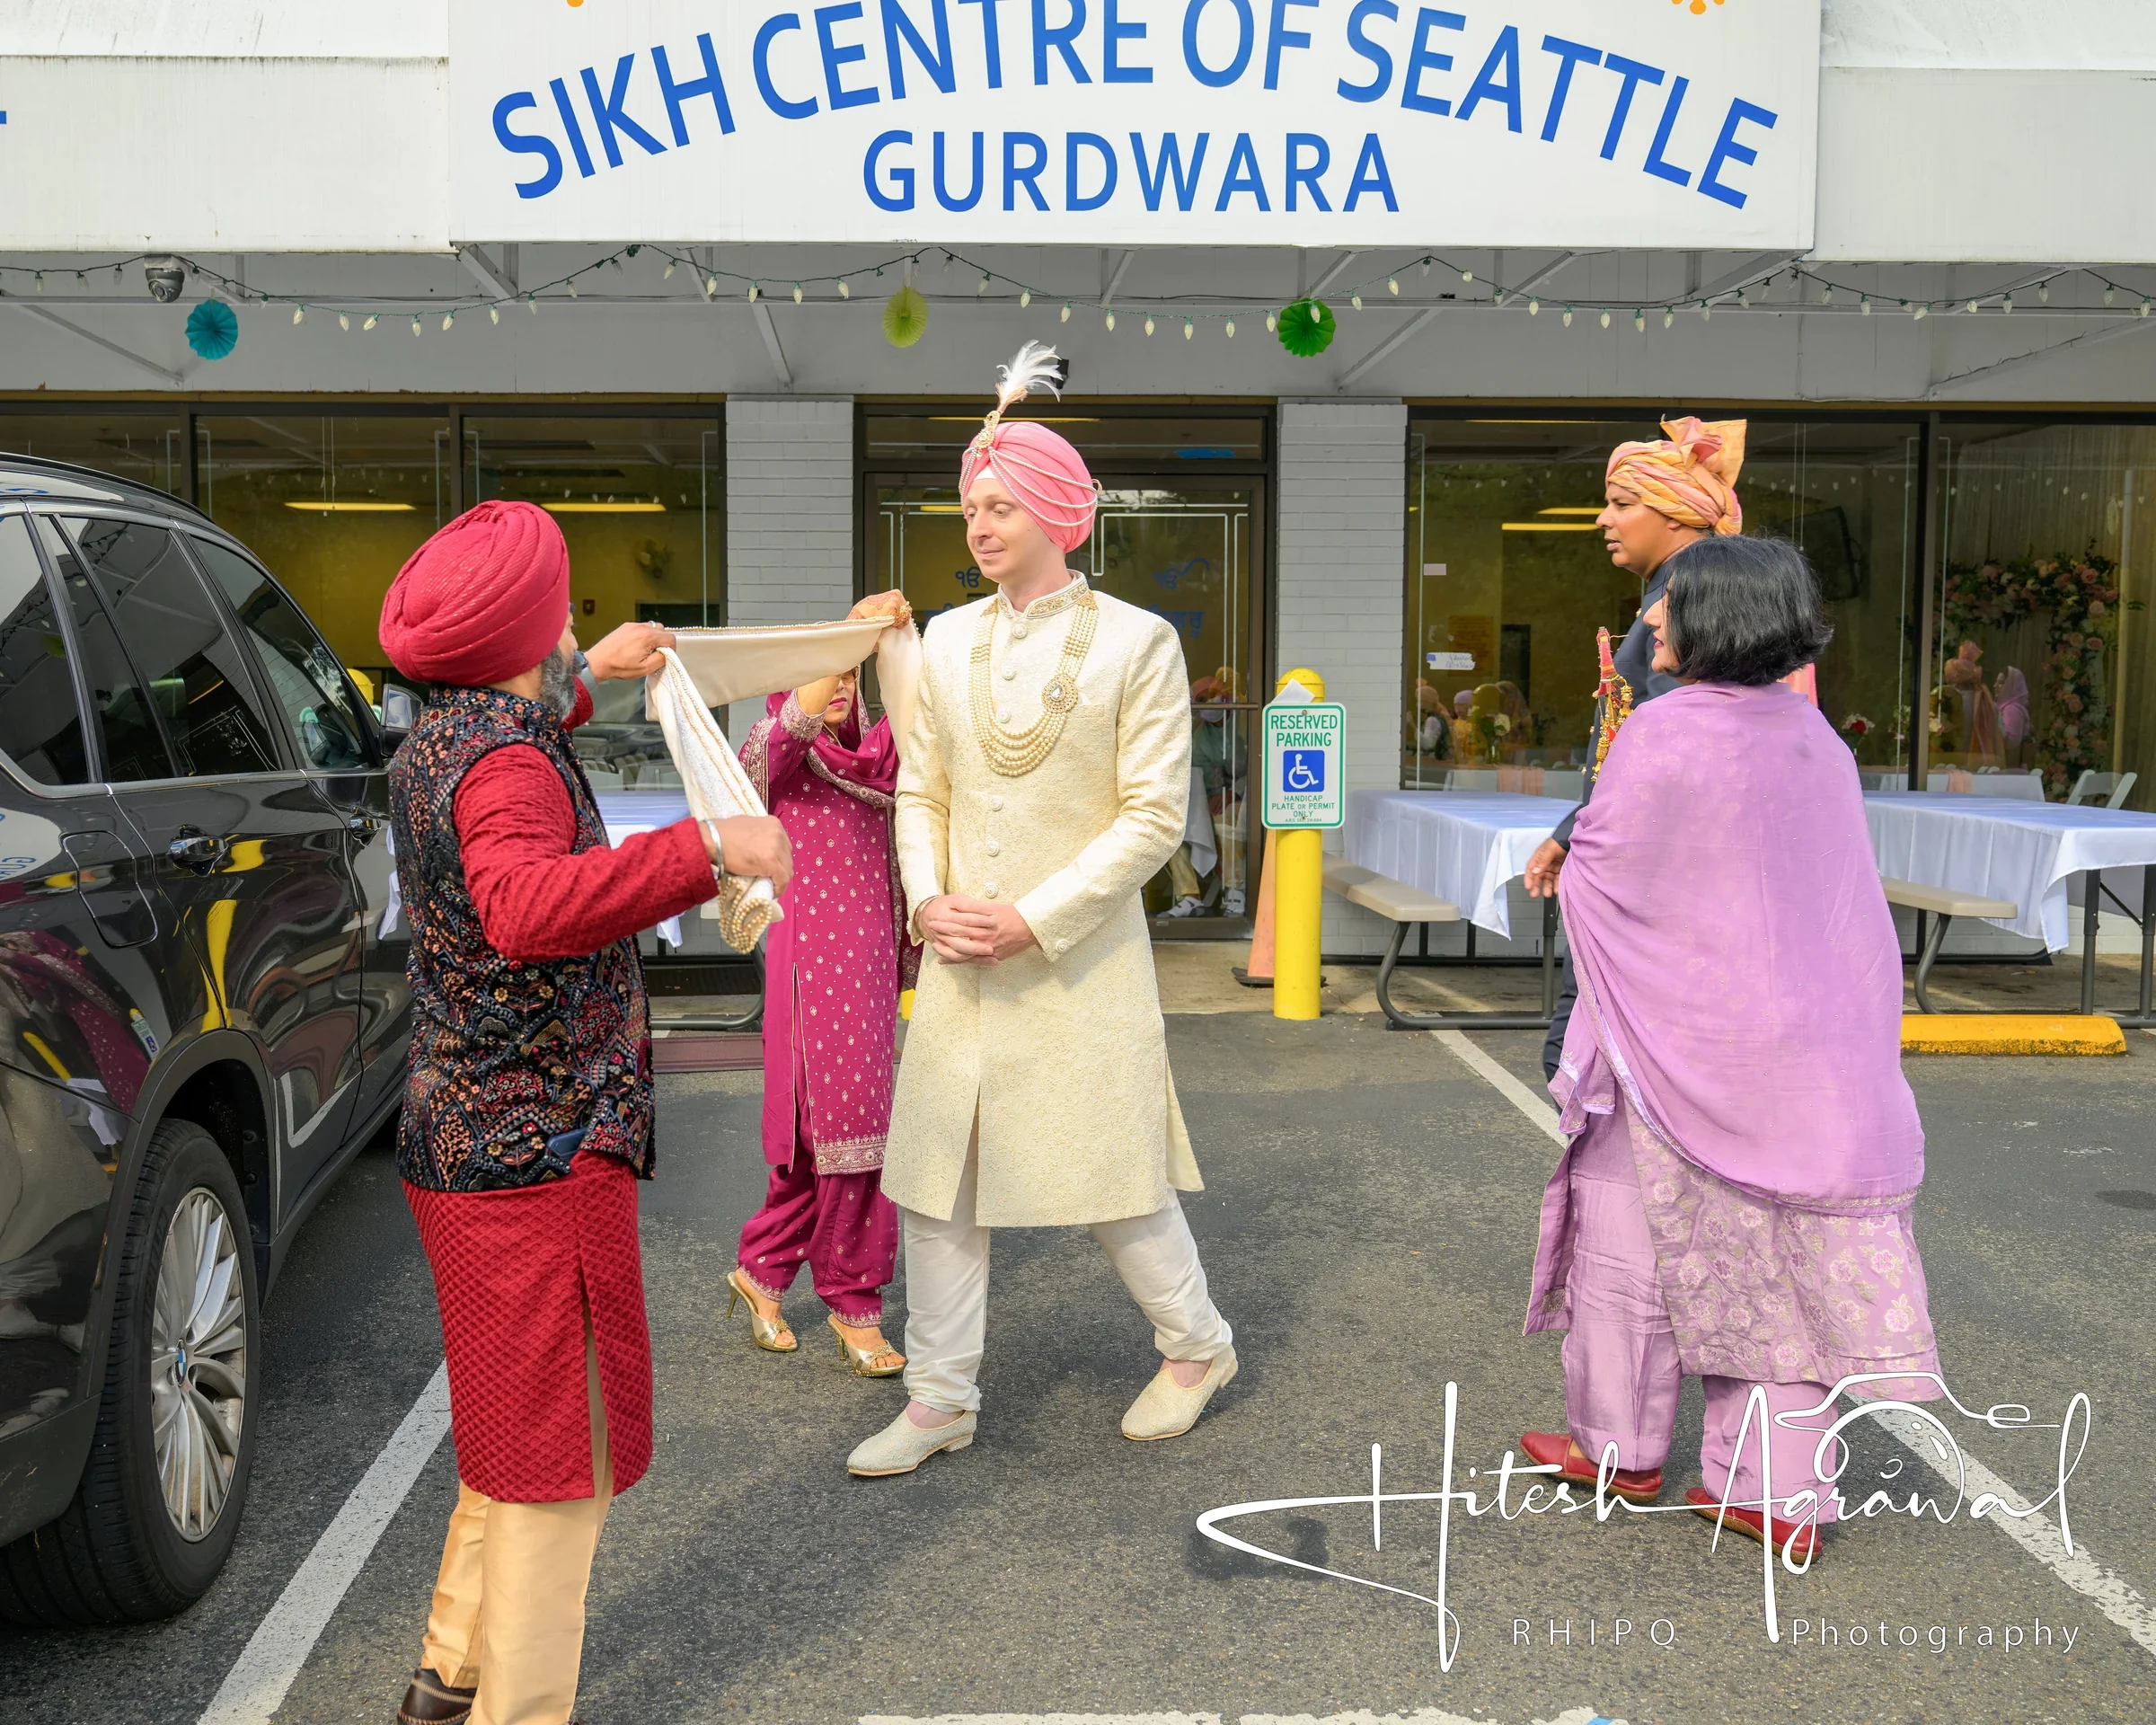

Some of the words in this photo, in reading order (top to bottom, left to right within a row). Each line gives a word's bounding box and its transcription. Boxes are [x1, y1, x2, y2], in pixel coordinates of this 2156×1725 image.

[492, 33, 737, 199] SIKH
[753, 0, 1153, 120] CENTRE
[1182, 0, 1320, 91] OF
[1337, 0, 1778, 209] SEATTLE
[863, 129, 1400, 213] GURDWARA
[1270, 714, 1338, 730] RESERVED
[1277, 732, 1331, 747] PARKING
[1271, 802, 1294, 810] PLATE
